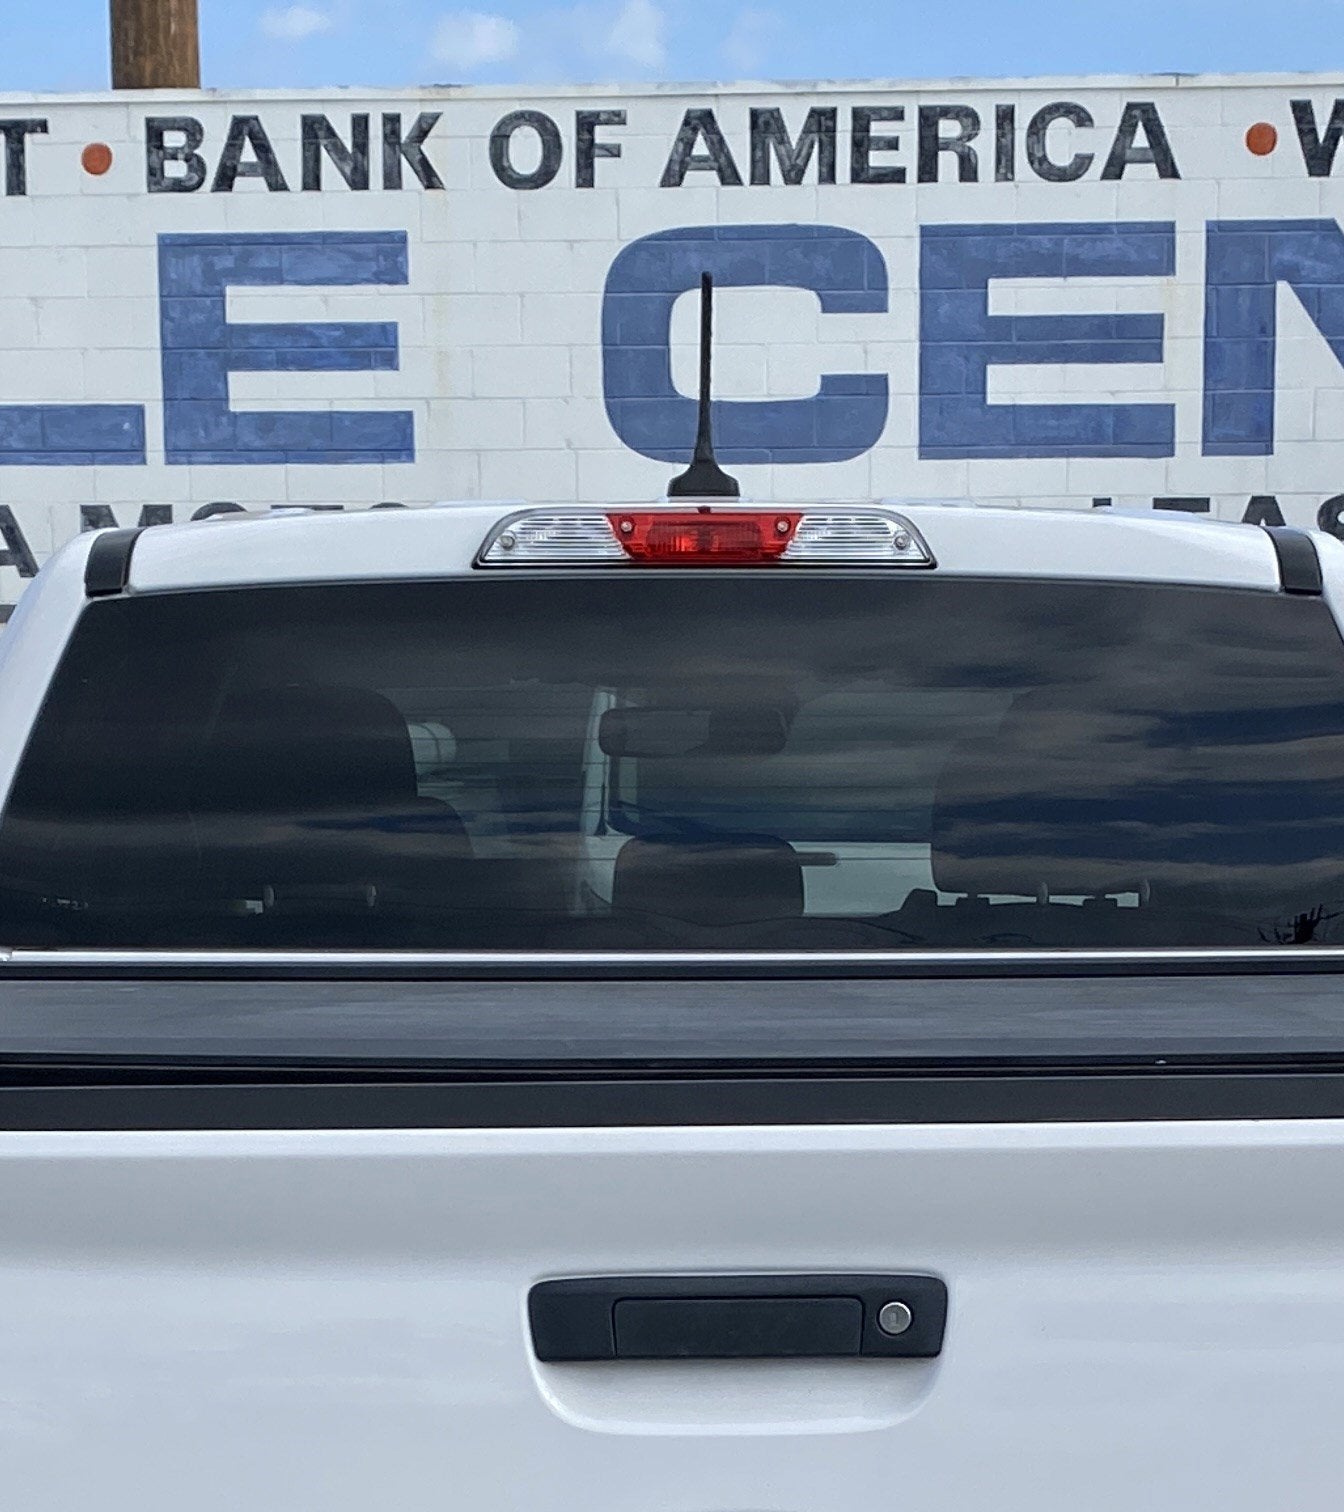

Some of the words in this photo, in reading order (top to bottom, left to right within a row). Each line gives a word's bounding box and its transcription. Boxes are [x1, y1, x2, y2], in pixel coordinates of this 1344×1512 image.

[145, 112, 446, 193] BANK
[489, 110, 627, 190] OF
[659, 101, 1181, 187] AMERICA
